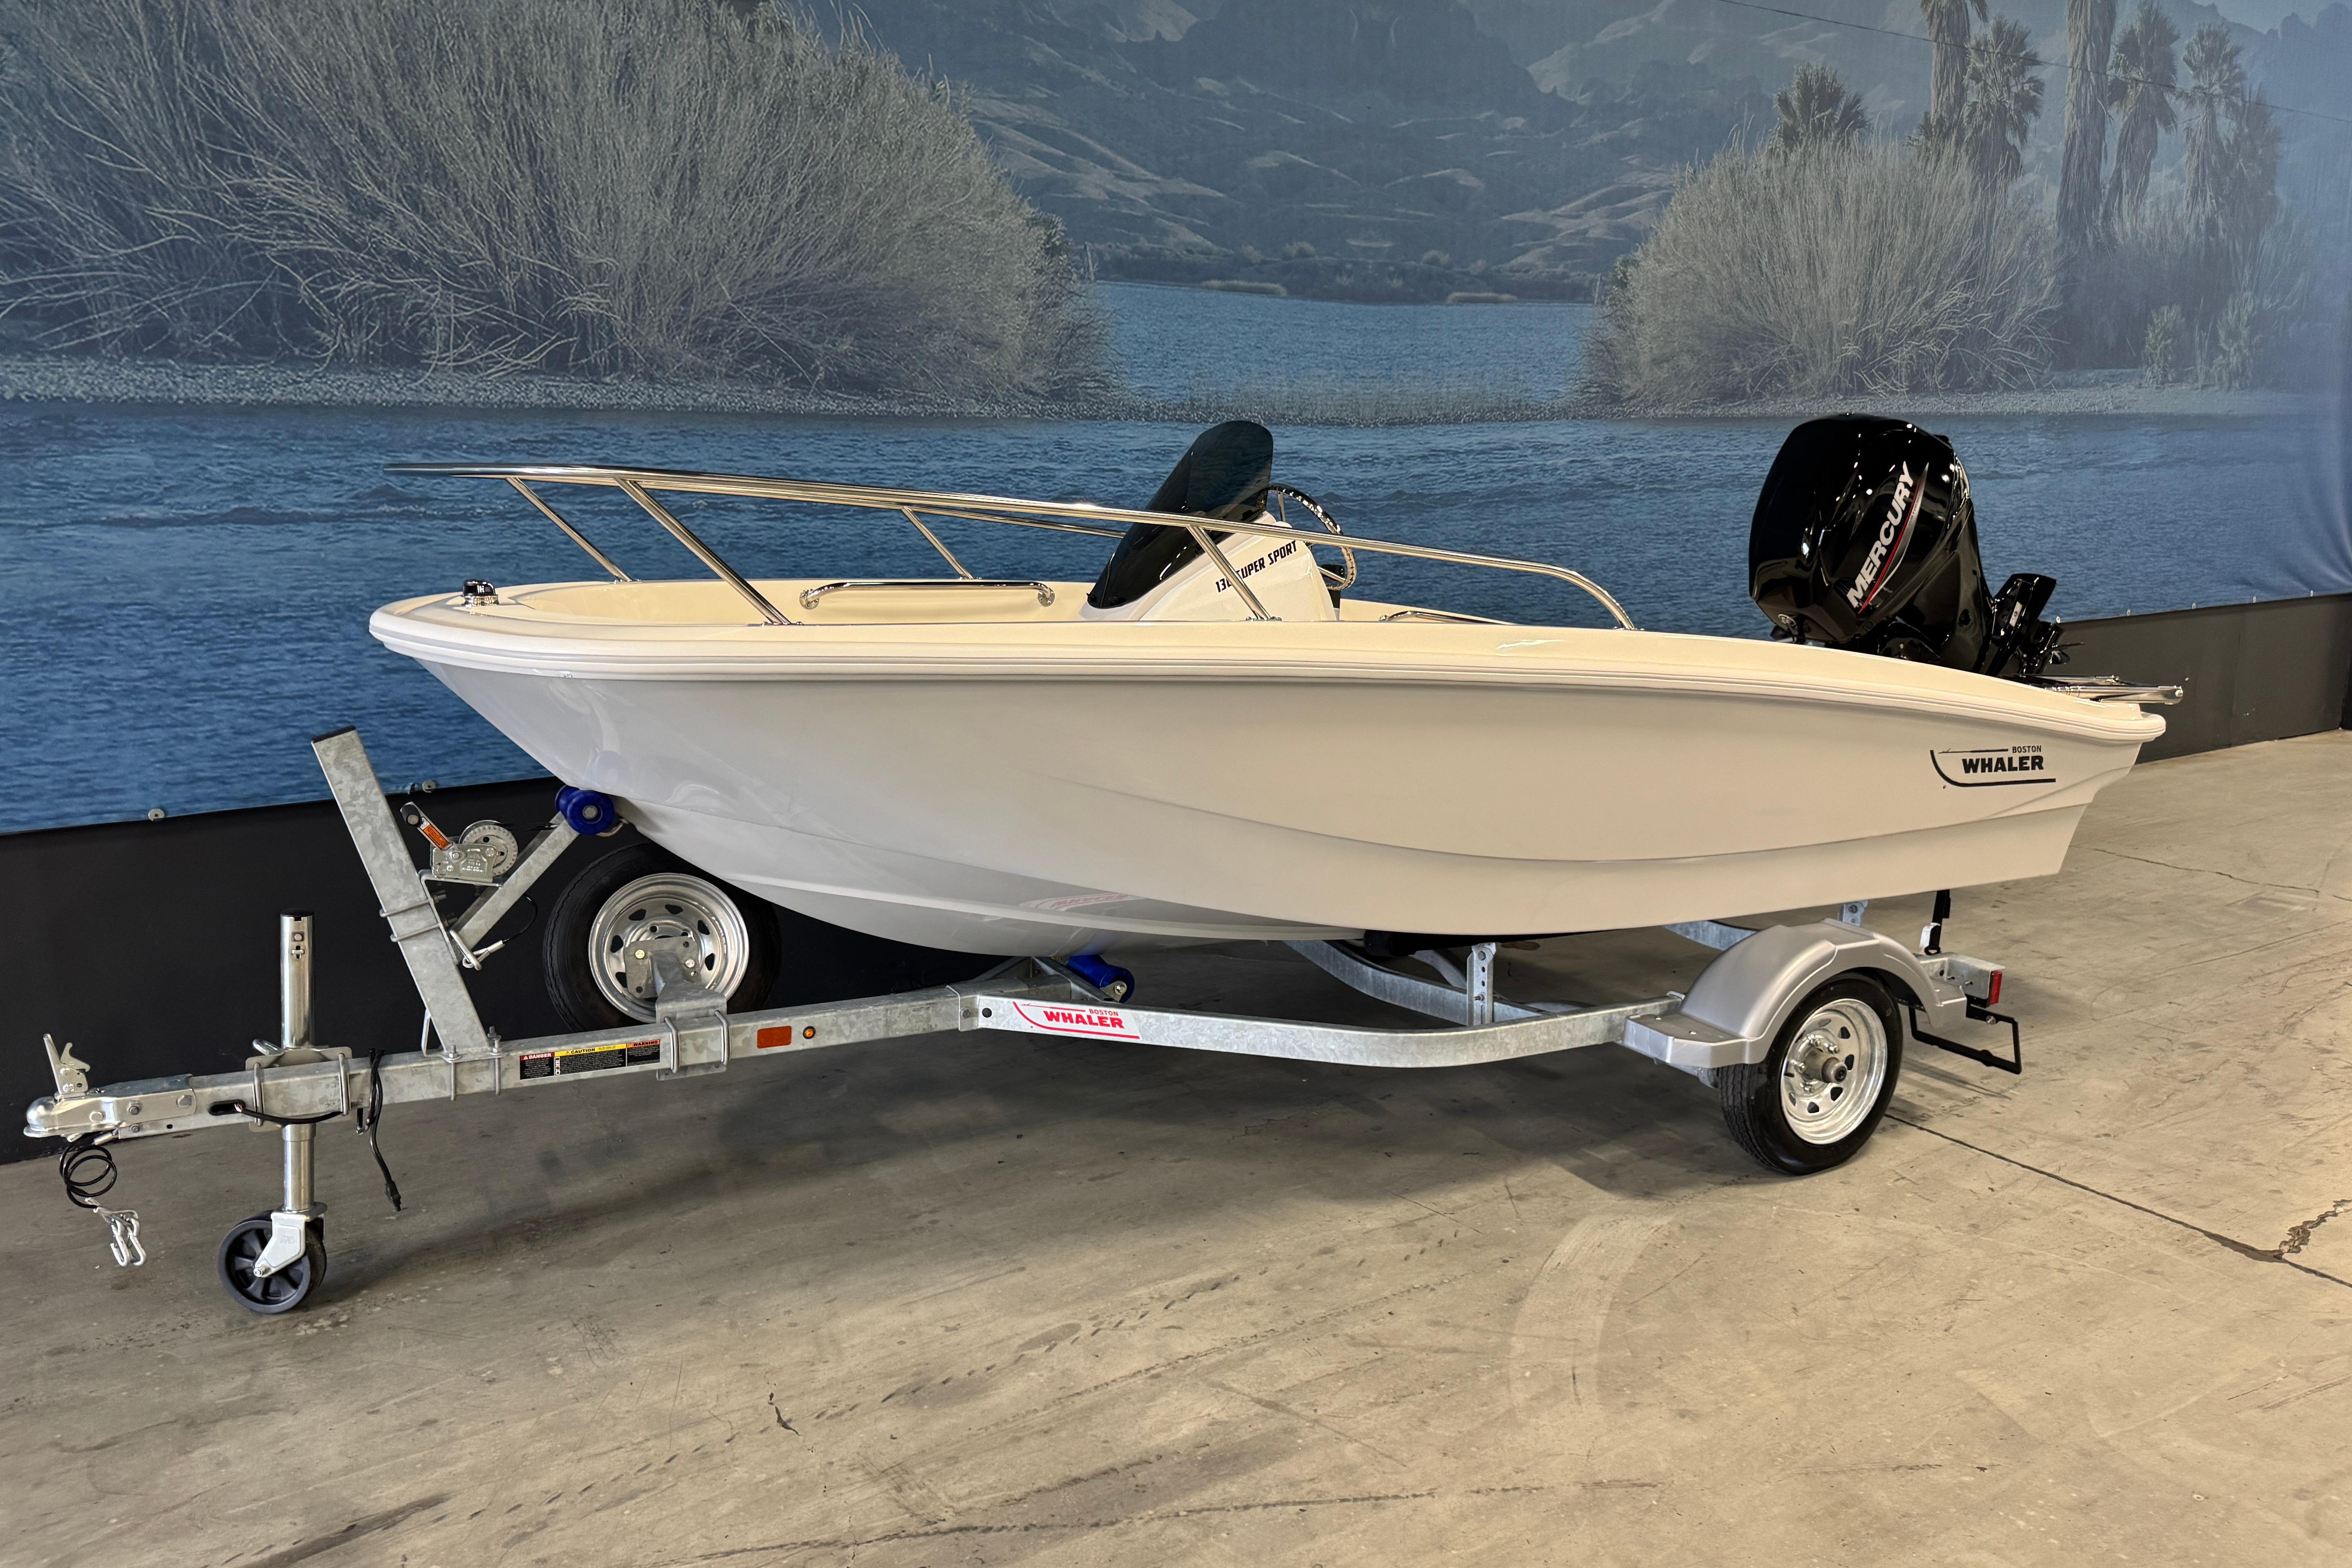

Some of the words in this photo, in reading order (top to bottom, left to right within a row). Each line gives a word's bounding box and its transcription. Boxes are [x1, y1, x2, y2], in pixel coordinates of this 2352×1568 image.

[1847, 461, 1913, 608] MERCURY
[1267, 540, 1297, 565] SPORT
[1962, 756, 2044, 773] WHALER
[1043, 1011, 1125, 1029] WHALER
